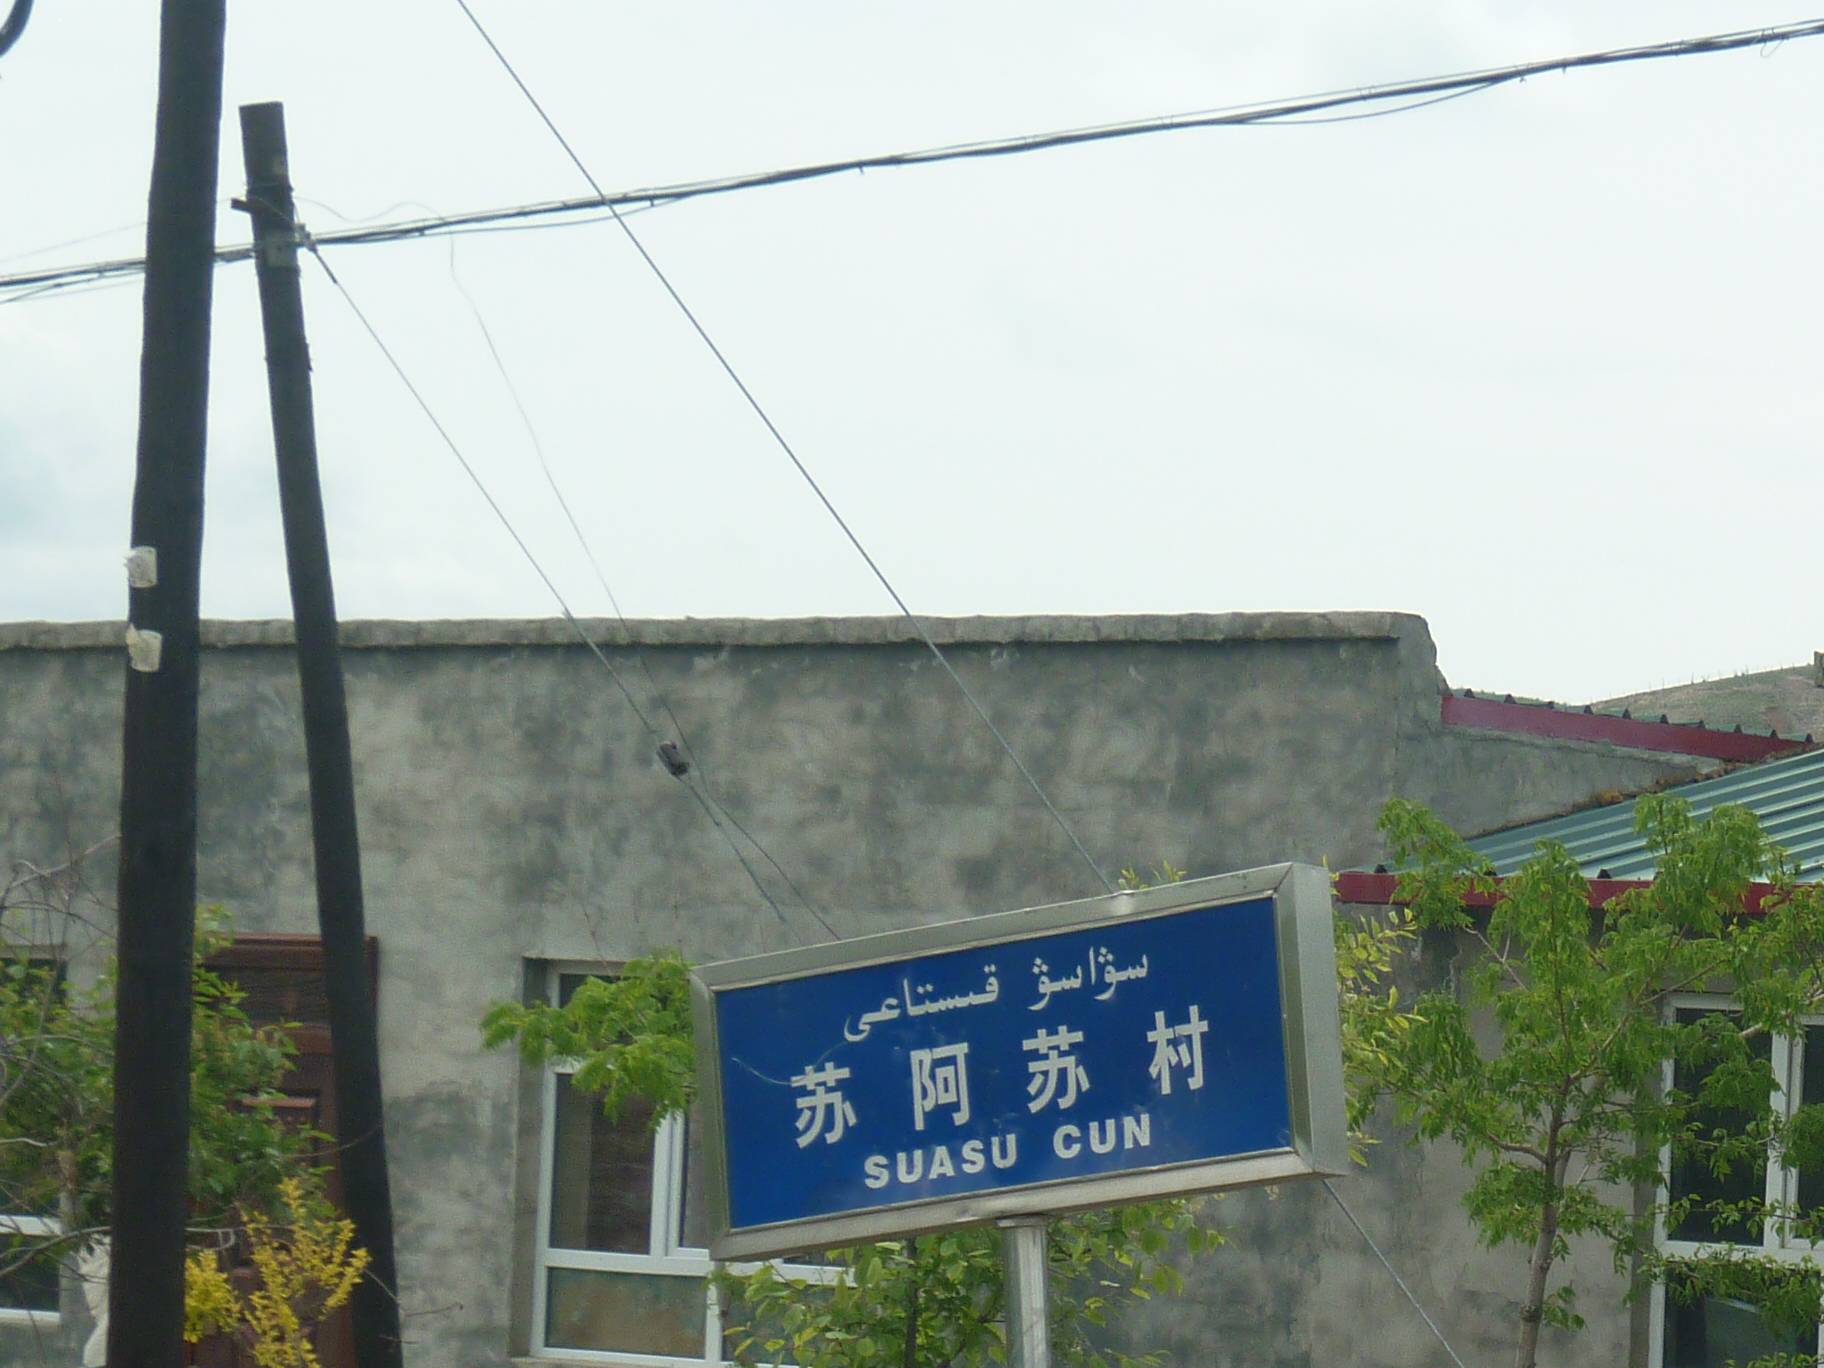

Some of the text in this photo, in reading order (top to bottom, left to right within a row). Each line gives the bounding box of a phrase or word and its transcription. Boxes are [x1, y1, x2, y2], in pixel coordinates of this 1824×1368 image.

[791, 1005, 1209, 1148] 苏阿苏村
[864, 1113, 1151, 1189] SUASU CUN
